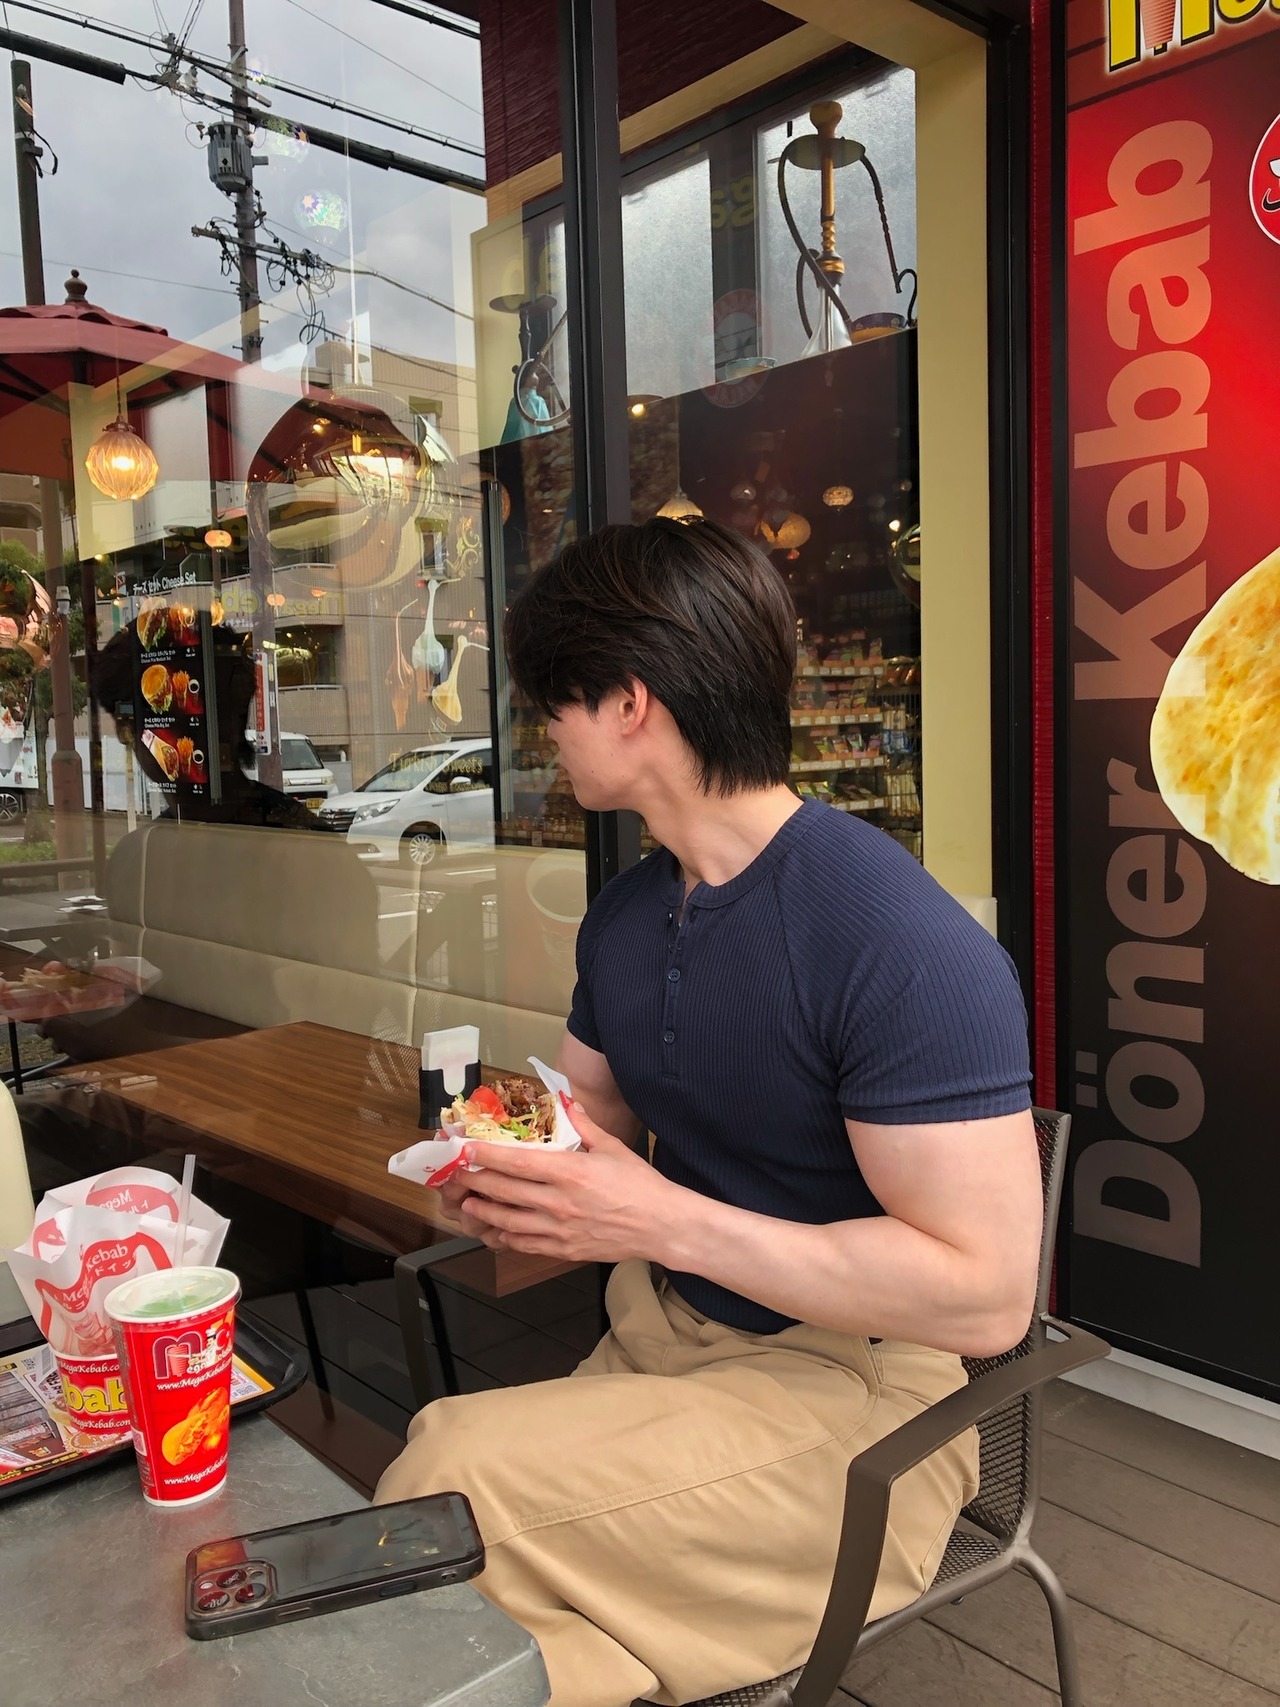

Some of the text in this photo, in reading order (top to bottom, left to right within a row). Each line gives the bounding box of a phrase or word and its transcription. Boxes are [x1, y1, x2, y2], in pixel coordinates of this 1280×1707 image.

[1074, 120, 1213, 699] Kebab
[185, 571, 196, 584] Set
[442, 752, 483, 774] Sweets
[1073, 757, 1207, 1269] Döner
